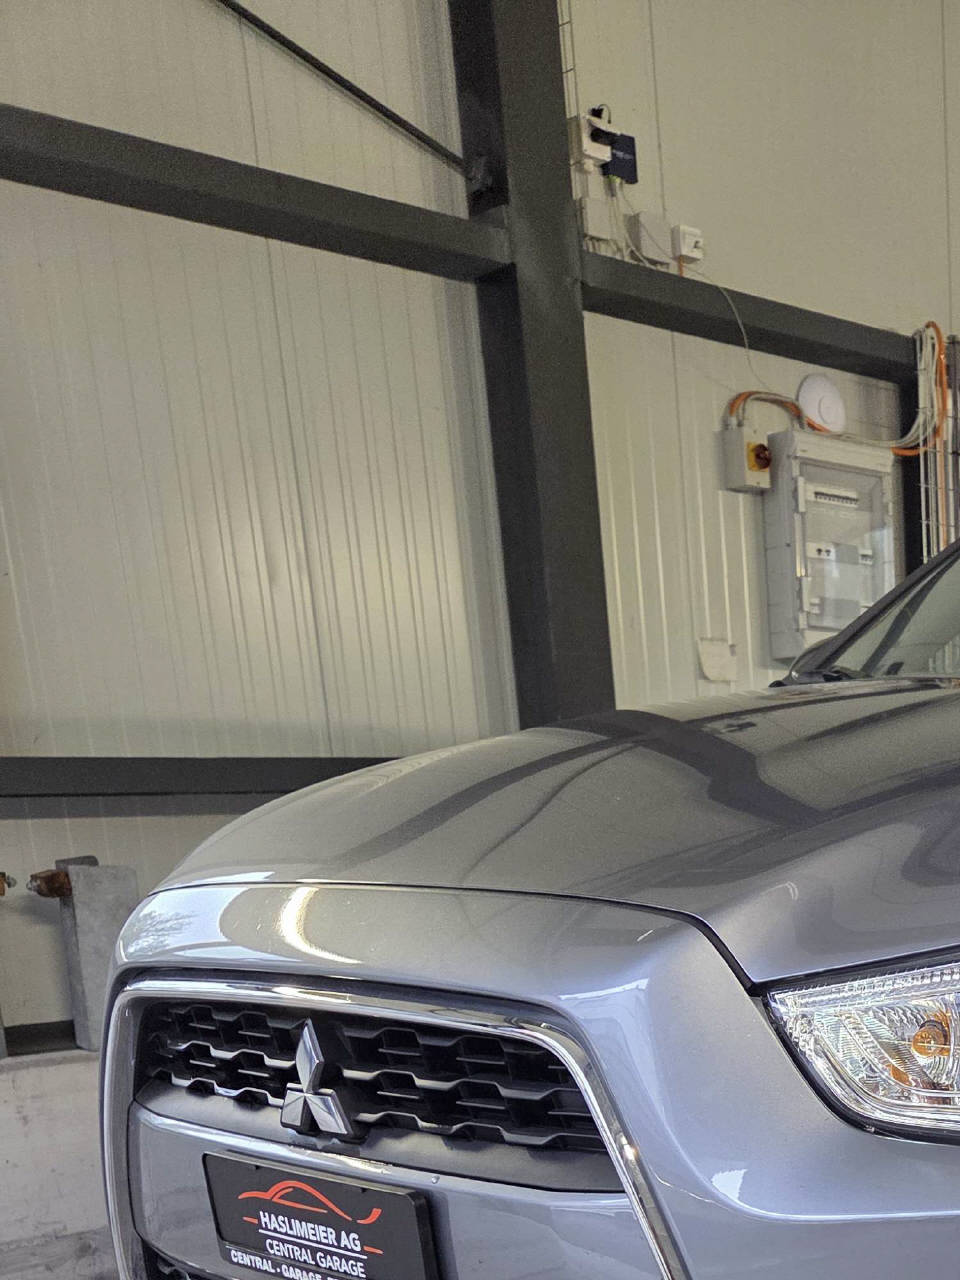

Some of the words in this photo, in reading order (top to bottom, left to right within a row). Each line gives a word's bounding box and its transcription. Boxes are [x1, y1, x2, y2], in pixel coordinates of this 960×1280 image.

[259, 1211, 337, 1246] HASLIMEIER
[340, 1231, 361, 1252] AG
[230, 1249, 275, 1273] CENTRAL
[265, 1239, 315, 1265] CENTRAL
[316, 1251, 367, 1278] GARAGE
